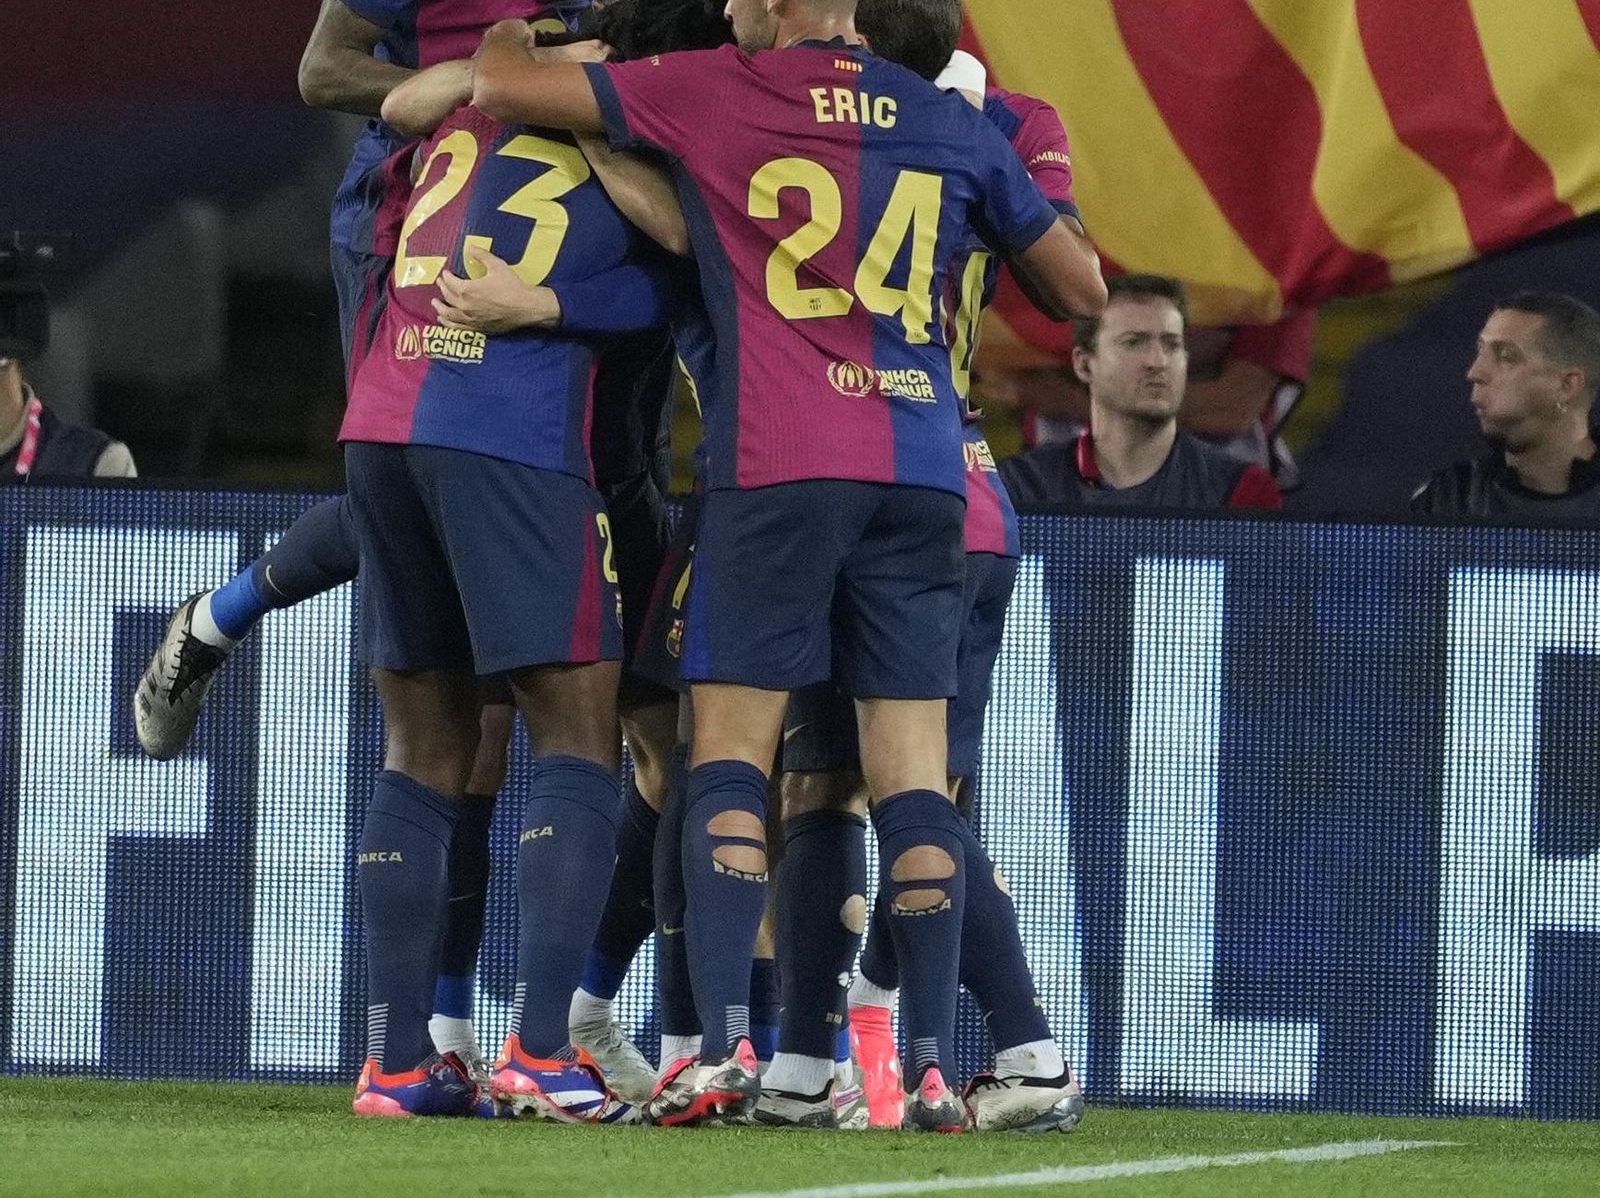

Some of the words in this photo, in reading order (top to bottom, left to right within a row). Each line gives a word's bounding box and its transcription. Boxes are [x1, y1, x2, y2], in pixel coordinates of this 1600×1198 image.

[808, 87, 898, 129] ERIC
[395, 129, 591, 289] 23
[747, 157, 943, 345] 24
[422, 325, 487, 348] UNHCR
[422, 339, 485, 359] ACNUR
[878, 375, 936, 399] ANUR
[8, 524, 1322, 1102] FIAL
